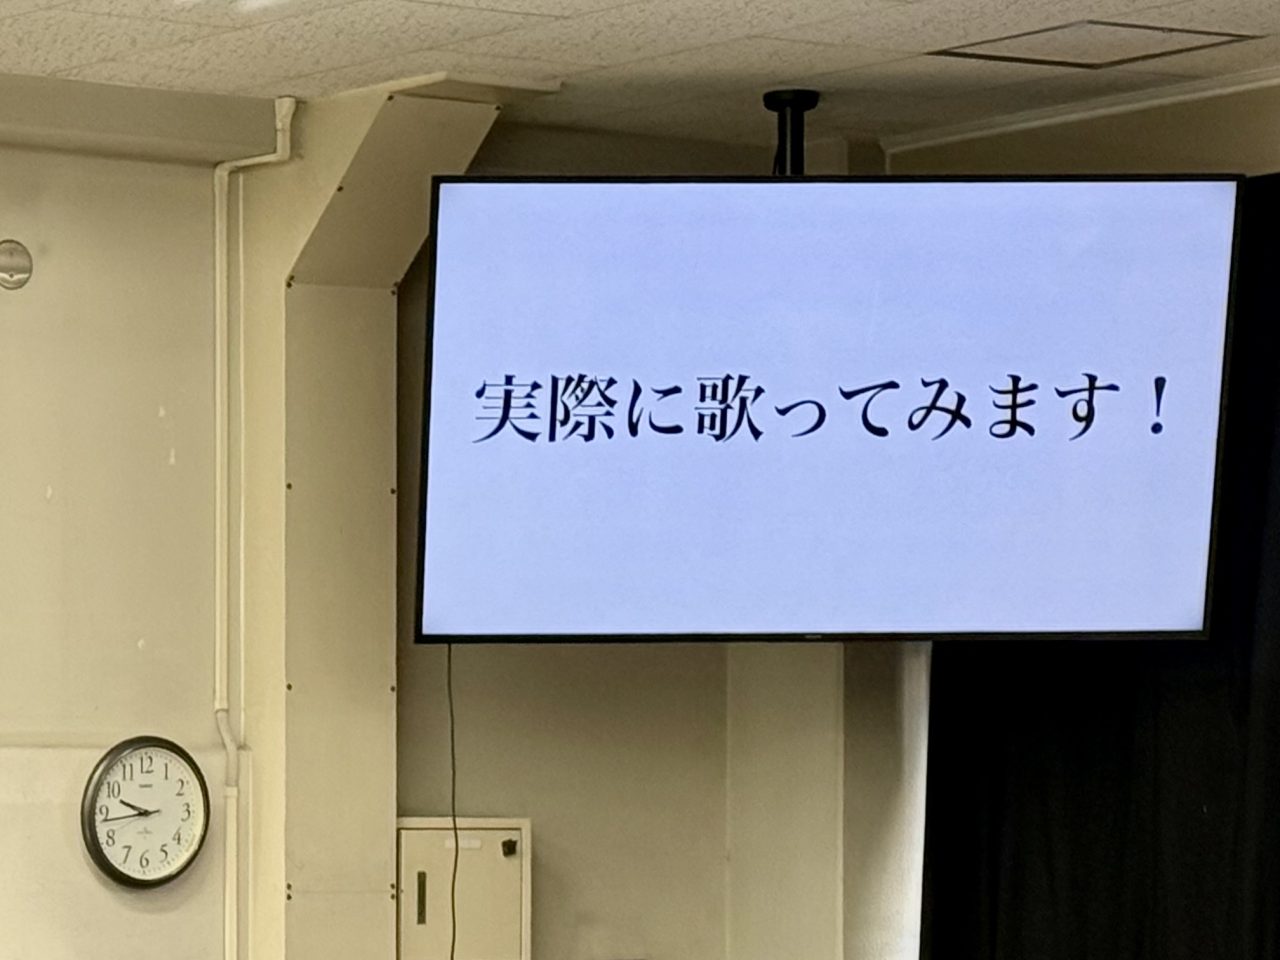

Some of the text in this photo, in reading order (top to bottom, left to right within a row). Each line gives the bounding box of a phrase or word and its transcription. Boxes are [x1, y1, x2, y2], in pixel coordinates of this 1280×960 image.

[472, 373, 1167, 442] 実際に歌ってみます！
[122, 763, 134, 781] 11
[140, 755, 154, 774] 12
[164, 762, 169, 780] 1
[106, 780, 121, 799] 10
[176, 779, 185, 797] 2
[99, 804, 109, 822] 9
[181, 803, 191, 822] 3
[106, 829, 116, 847] 8
[172, 828, 182, 845] 4
[121, 845, 132, 864] 7
[140, 850, 150, 868] 6
[160, 844, 168, 862] 5
